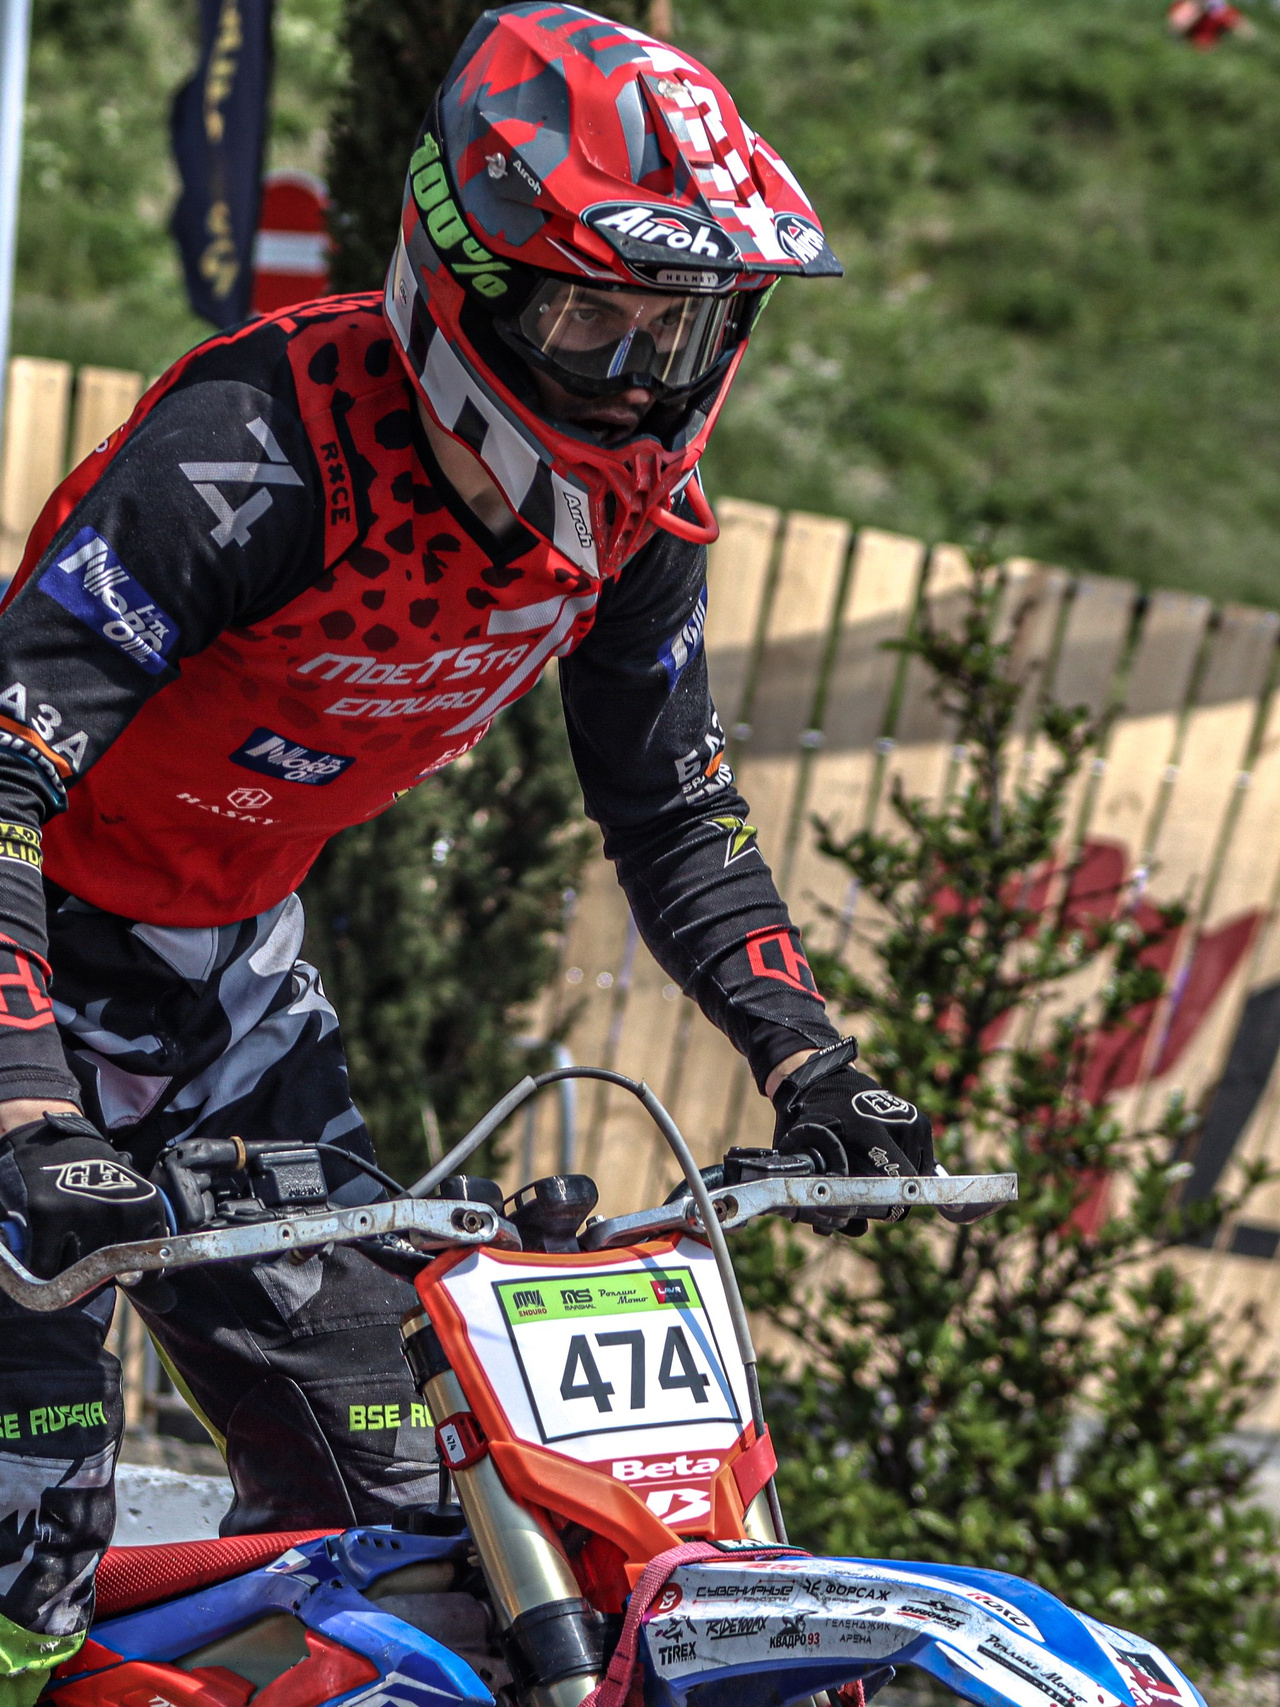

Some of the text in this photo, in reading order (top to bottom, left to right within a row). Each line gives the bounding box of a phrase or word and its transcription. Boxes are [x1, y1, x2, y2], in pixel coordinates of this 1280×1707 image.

[513, 160, 542, 196] Airoh
[410, 132, 511, 298] 100%
[594, 207, 720, 258] Airoh
[666, 275, 713, 284] HELMET
[562, 490, 594, 548] Airoh
[324, 687, 486, 718] ENDURO
[518, 1308, 548, 1317] ENDURO
[559, 1325, 712, 1413] 474
[29, 1401, 108, 1436] RUSSIA
[349, 1403, 402, 1432] BSE
[445, 1434, 458, 1451] 474
[612, 1455, 721, 1481] Beta
[825, 1584, 892, 1601] ФОРСАЖ
[769, 1632, 821, 1649] КВАДРО 93
[839, 1633, 872, 1644] АРЕНА
